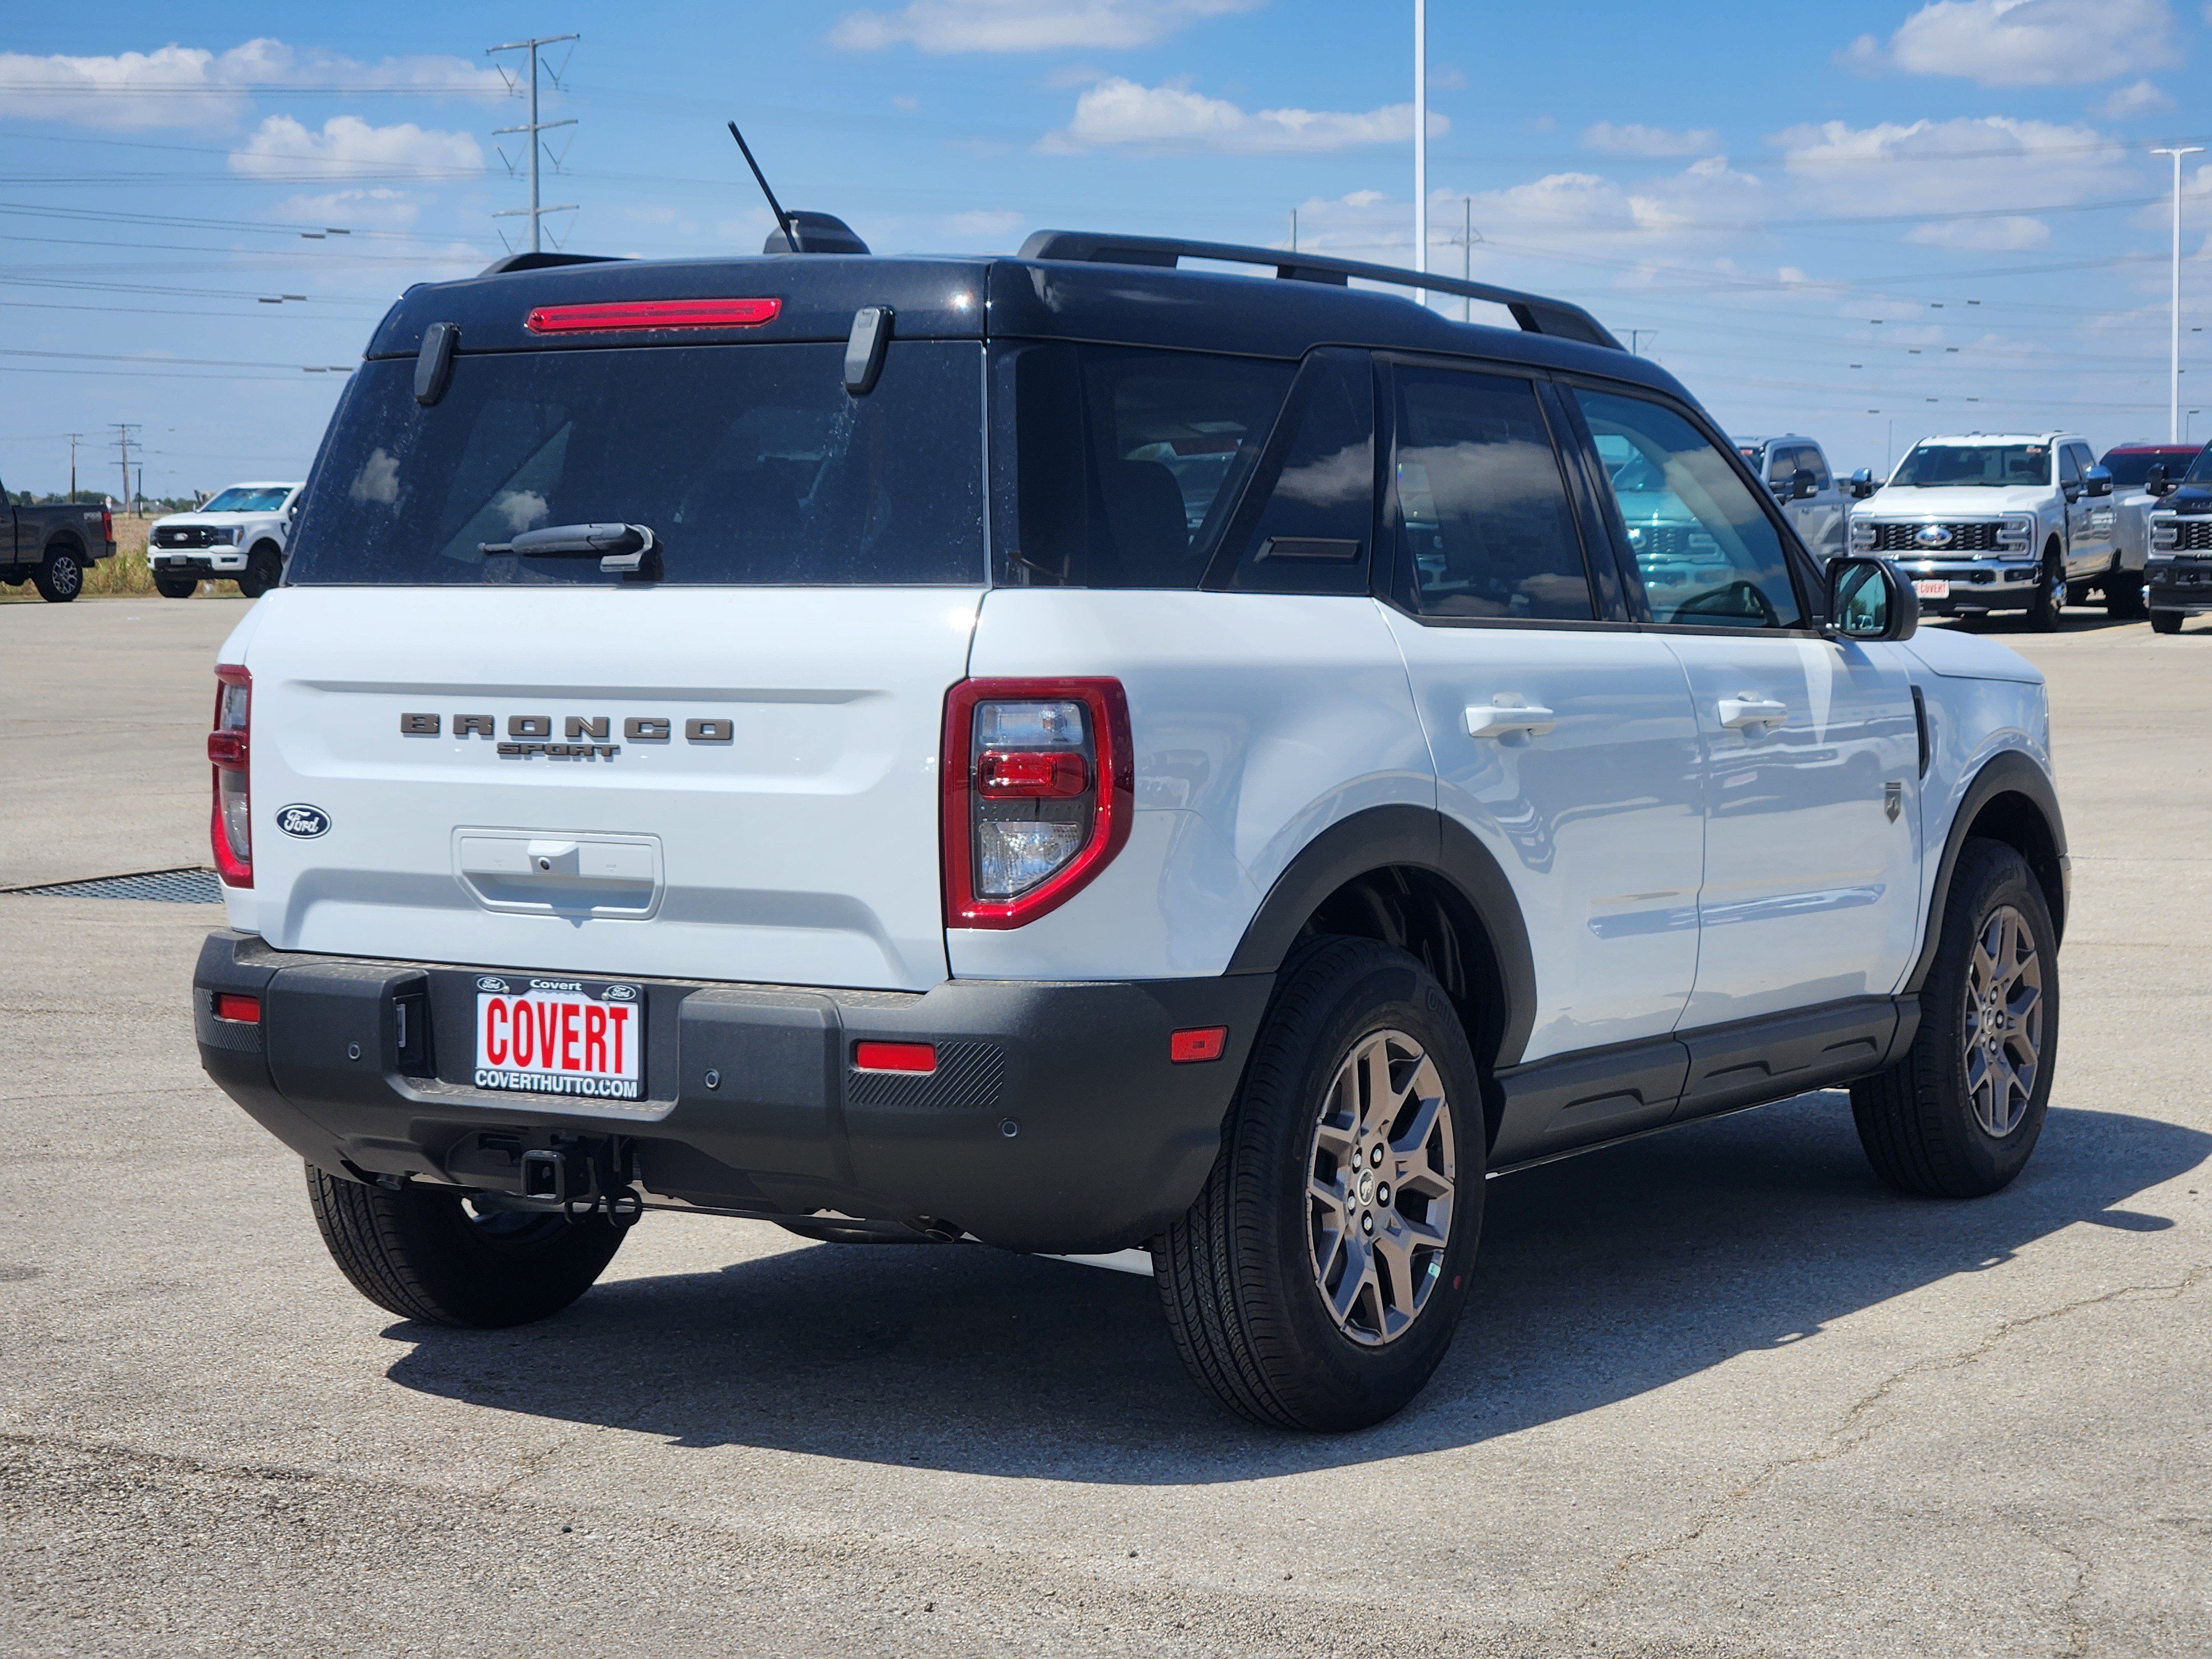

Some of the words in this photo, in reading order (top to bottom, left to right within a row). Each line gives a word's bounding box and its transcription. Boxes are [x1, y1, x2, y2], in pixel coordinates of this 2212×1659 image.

[1921, 582, 1946, 594] COVERT
[400, 713, 733, 740] BRONCO
[497, 742, 619, 757] SPORT
[529, 979, 582, 990] Covert
[487, 998, 628, 1074] COVERT
[475, 1070, 638, 1098] COVERTHUTTO.COM
